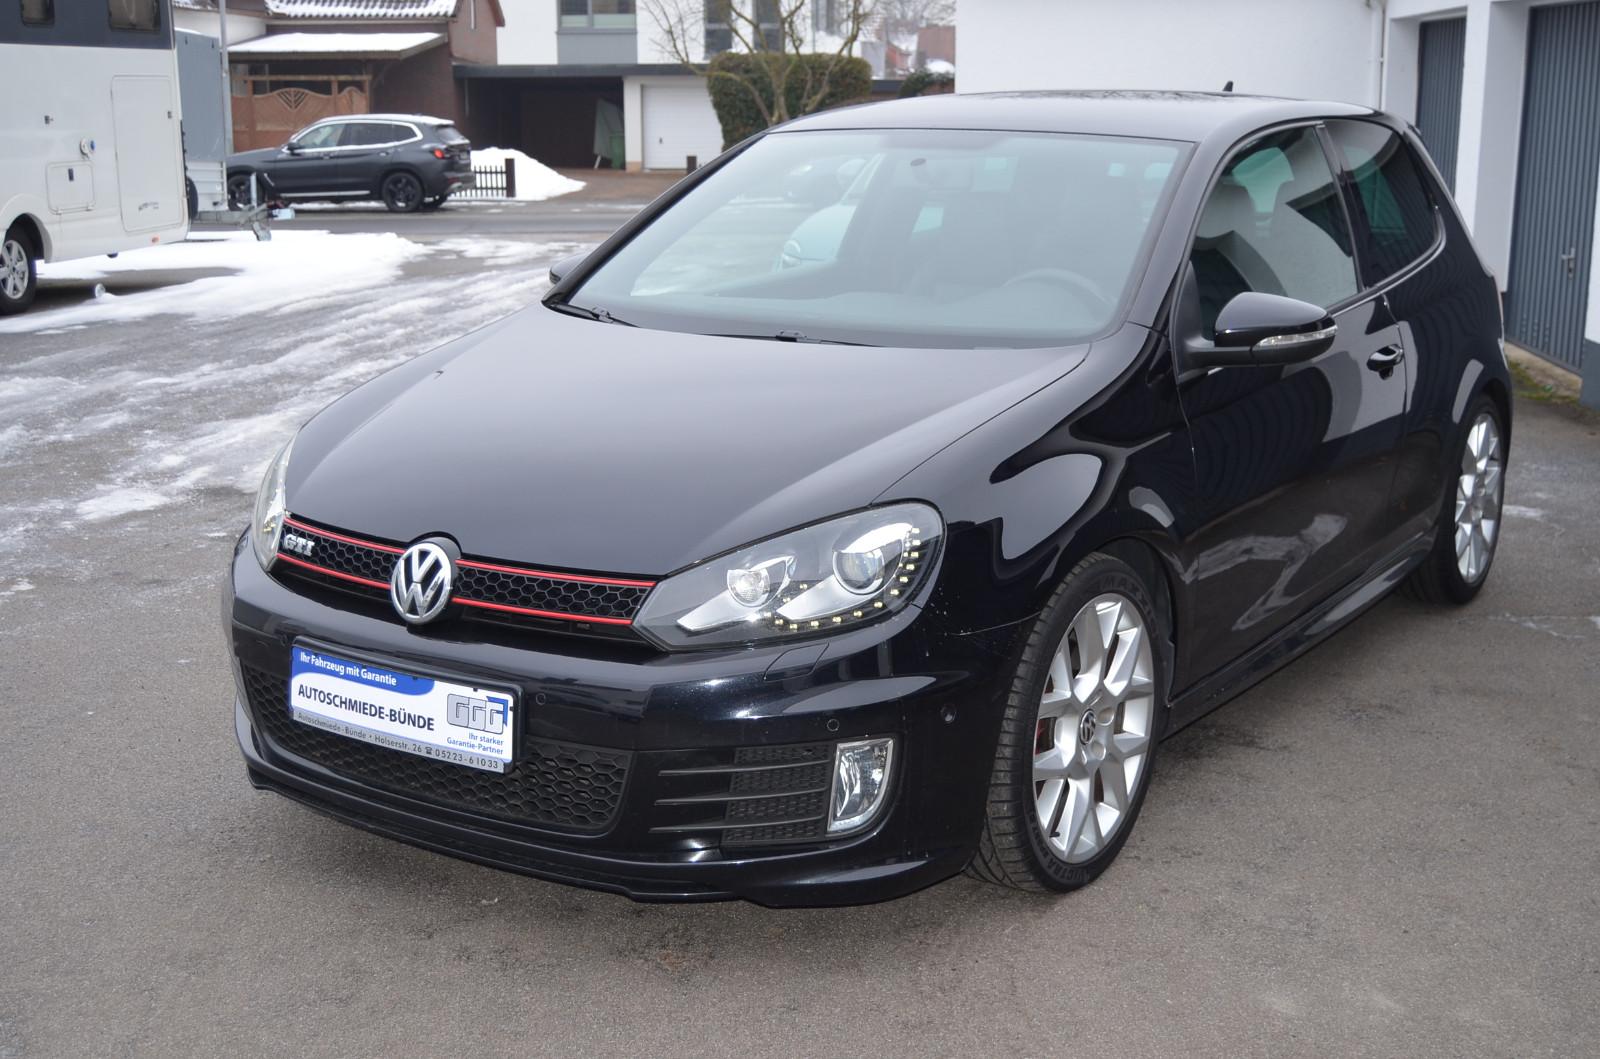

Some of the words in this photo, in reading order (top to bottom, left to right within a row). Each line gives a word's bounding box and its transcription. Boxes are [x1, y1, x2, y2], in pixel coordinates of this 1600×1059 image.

[283, 533, 315, 557] GTI
[300, 651, 310, 663] Ihr
[311, 655, 345, 675] Fahrzeug
[346, 665, 360, 677] mit
[360, 669, 397, 686] Garantie
[298, 684, 434, 731] AUTOSCHMIEDE-BÜNDE
[412, 743, 422, 753] 26
[447, 737, 503, 755] Garantie-Partner
[468, 732, 478, 741] Ihr
[479, 736, 504, 746] starker
